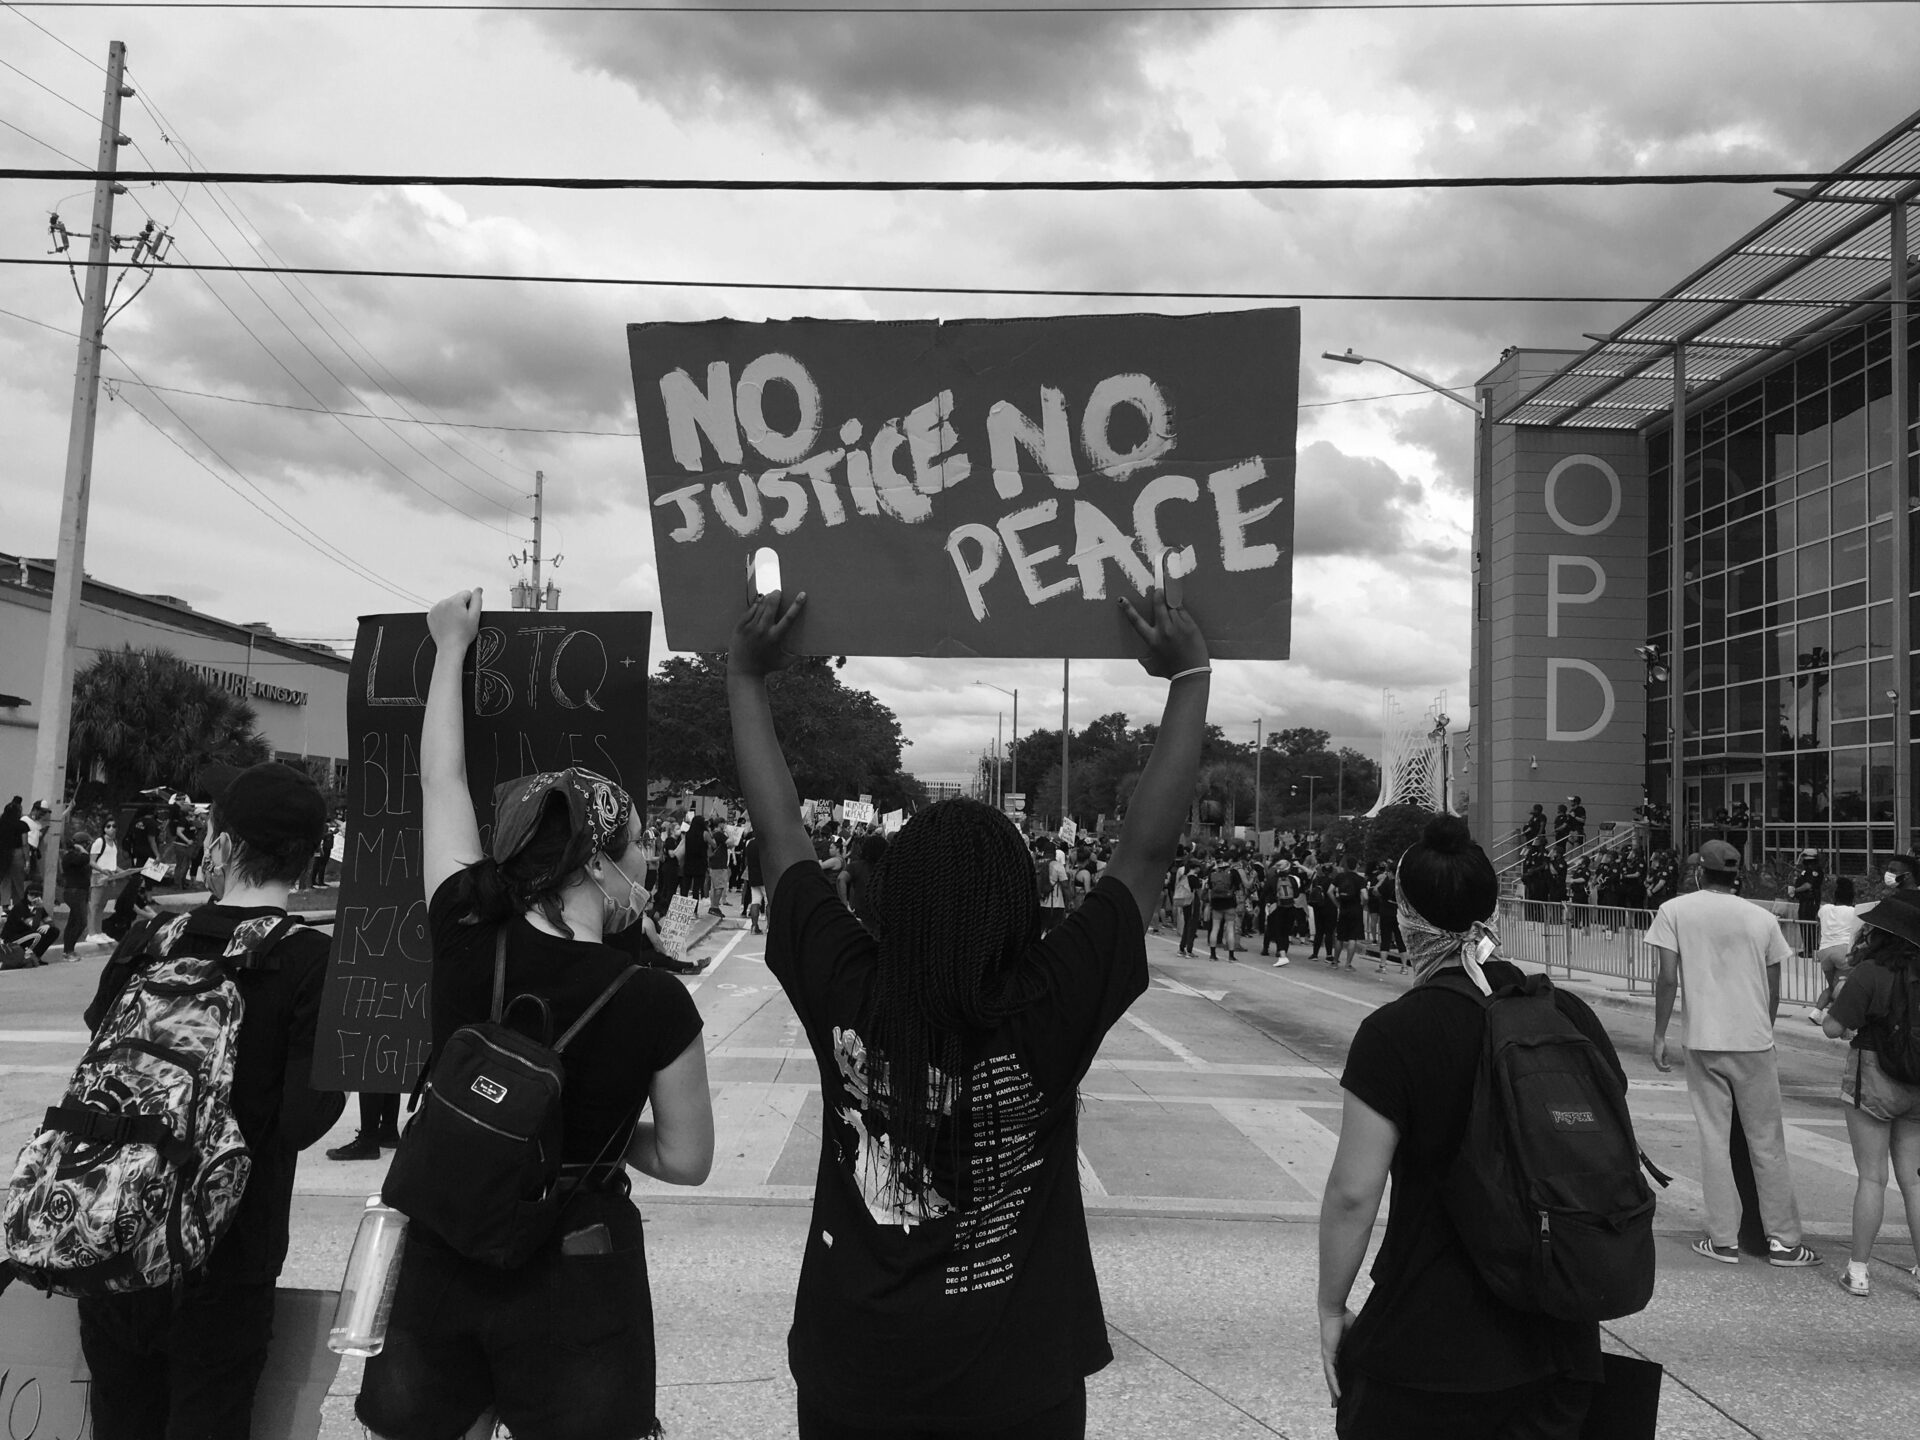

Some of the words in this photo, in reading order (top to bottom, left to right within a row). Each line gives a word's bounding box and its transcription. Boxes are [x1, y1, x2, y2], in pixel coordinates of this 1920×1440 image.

[660, 352, 822, 471] NO
[985, 372, 1178, 500] NO
[947, 456, 1283, 623] PEACE
[256, 682, 308, 705] KINGDOM
[336, 976, 426, 1019] THEM
[996, 1086, 1019, 1096] KANSAS
[998, 1096, 1022, 1107] DALLAS,
[998, 1151, 1012, 1160] NEW
[981, 1202, 993, 1212] SAN
[990, 1267, 1004, 1275] ANA,
[983, 1278, 1005, 1288] VEGAS,
